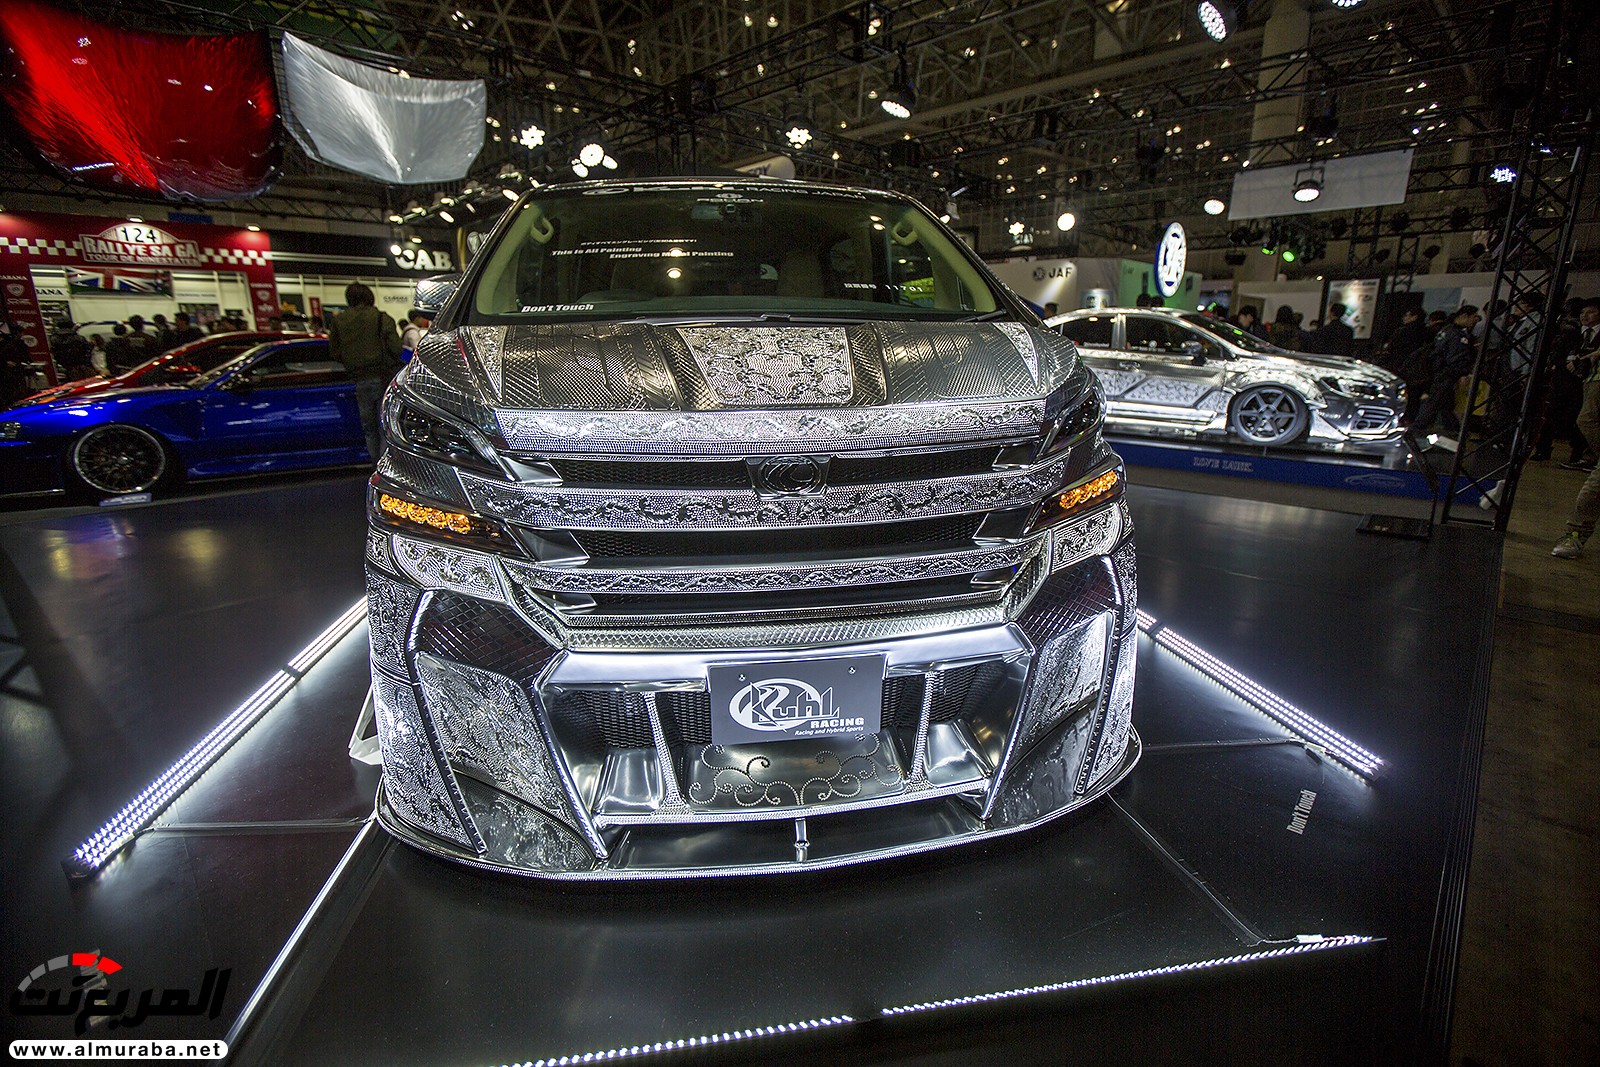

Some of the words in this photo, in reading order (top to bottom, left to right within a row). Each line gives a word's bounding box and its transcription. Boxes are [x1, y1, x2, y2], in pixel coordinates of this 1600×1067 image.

[121, 226, 157, 243] 124
[83, 237, 149, 256] RALLYE
[87, 253, 120, 262] TOUR
[1048, 266, 1072, 279] JAF
[885, 284, 923, 293] 11701
[521, 304, 554, 313] Don't
[555, 303, 594, 311] Touch
[810, 717, 865, 729] RACING
[826, 726, 845, 734] Hybrid
[845, 725, 864, 733] Sports
[1293, 789, 1317, 814] Touch
[1286, 811, 1309, 835] Don't
